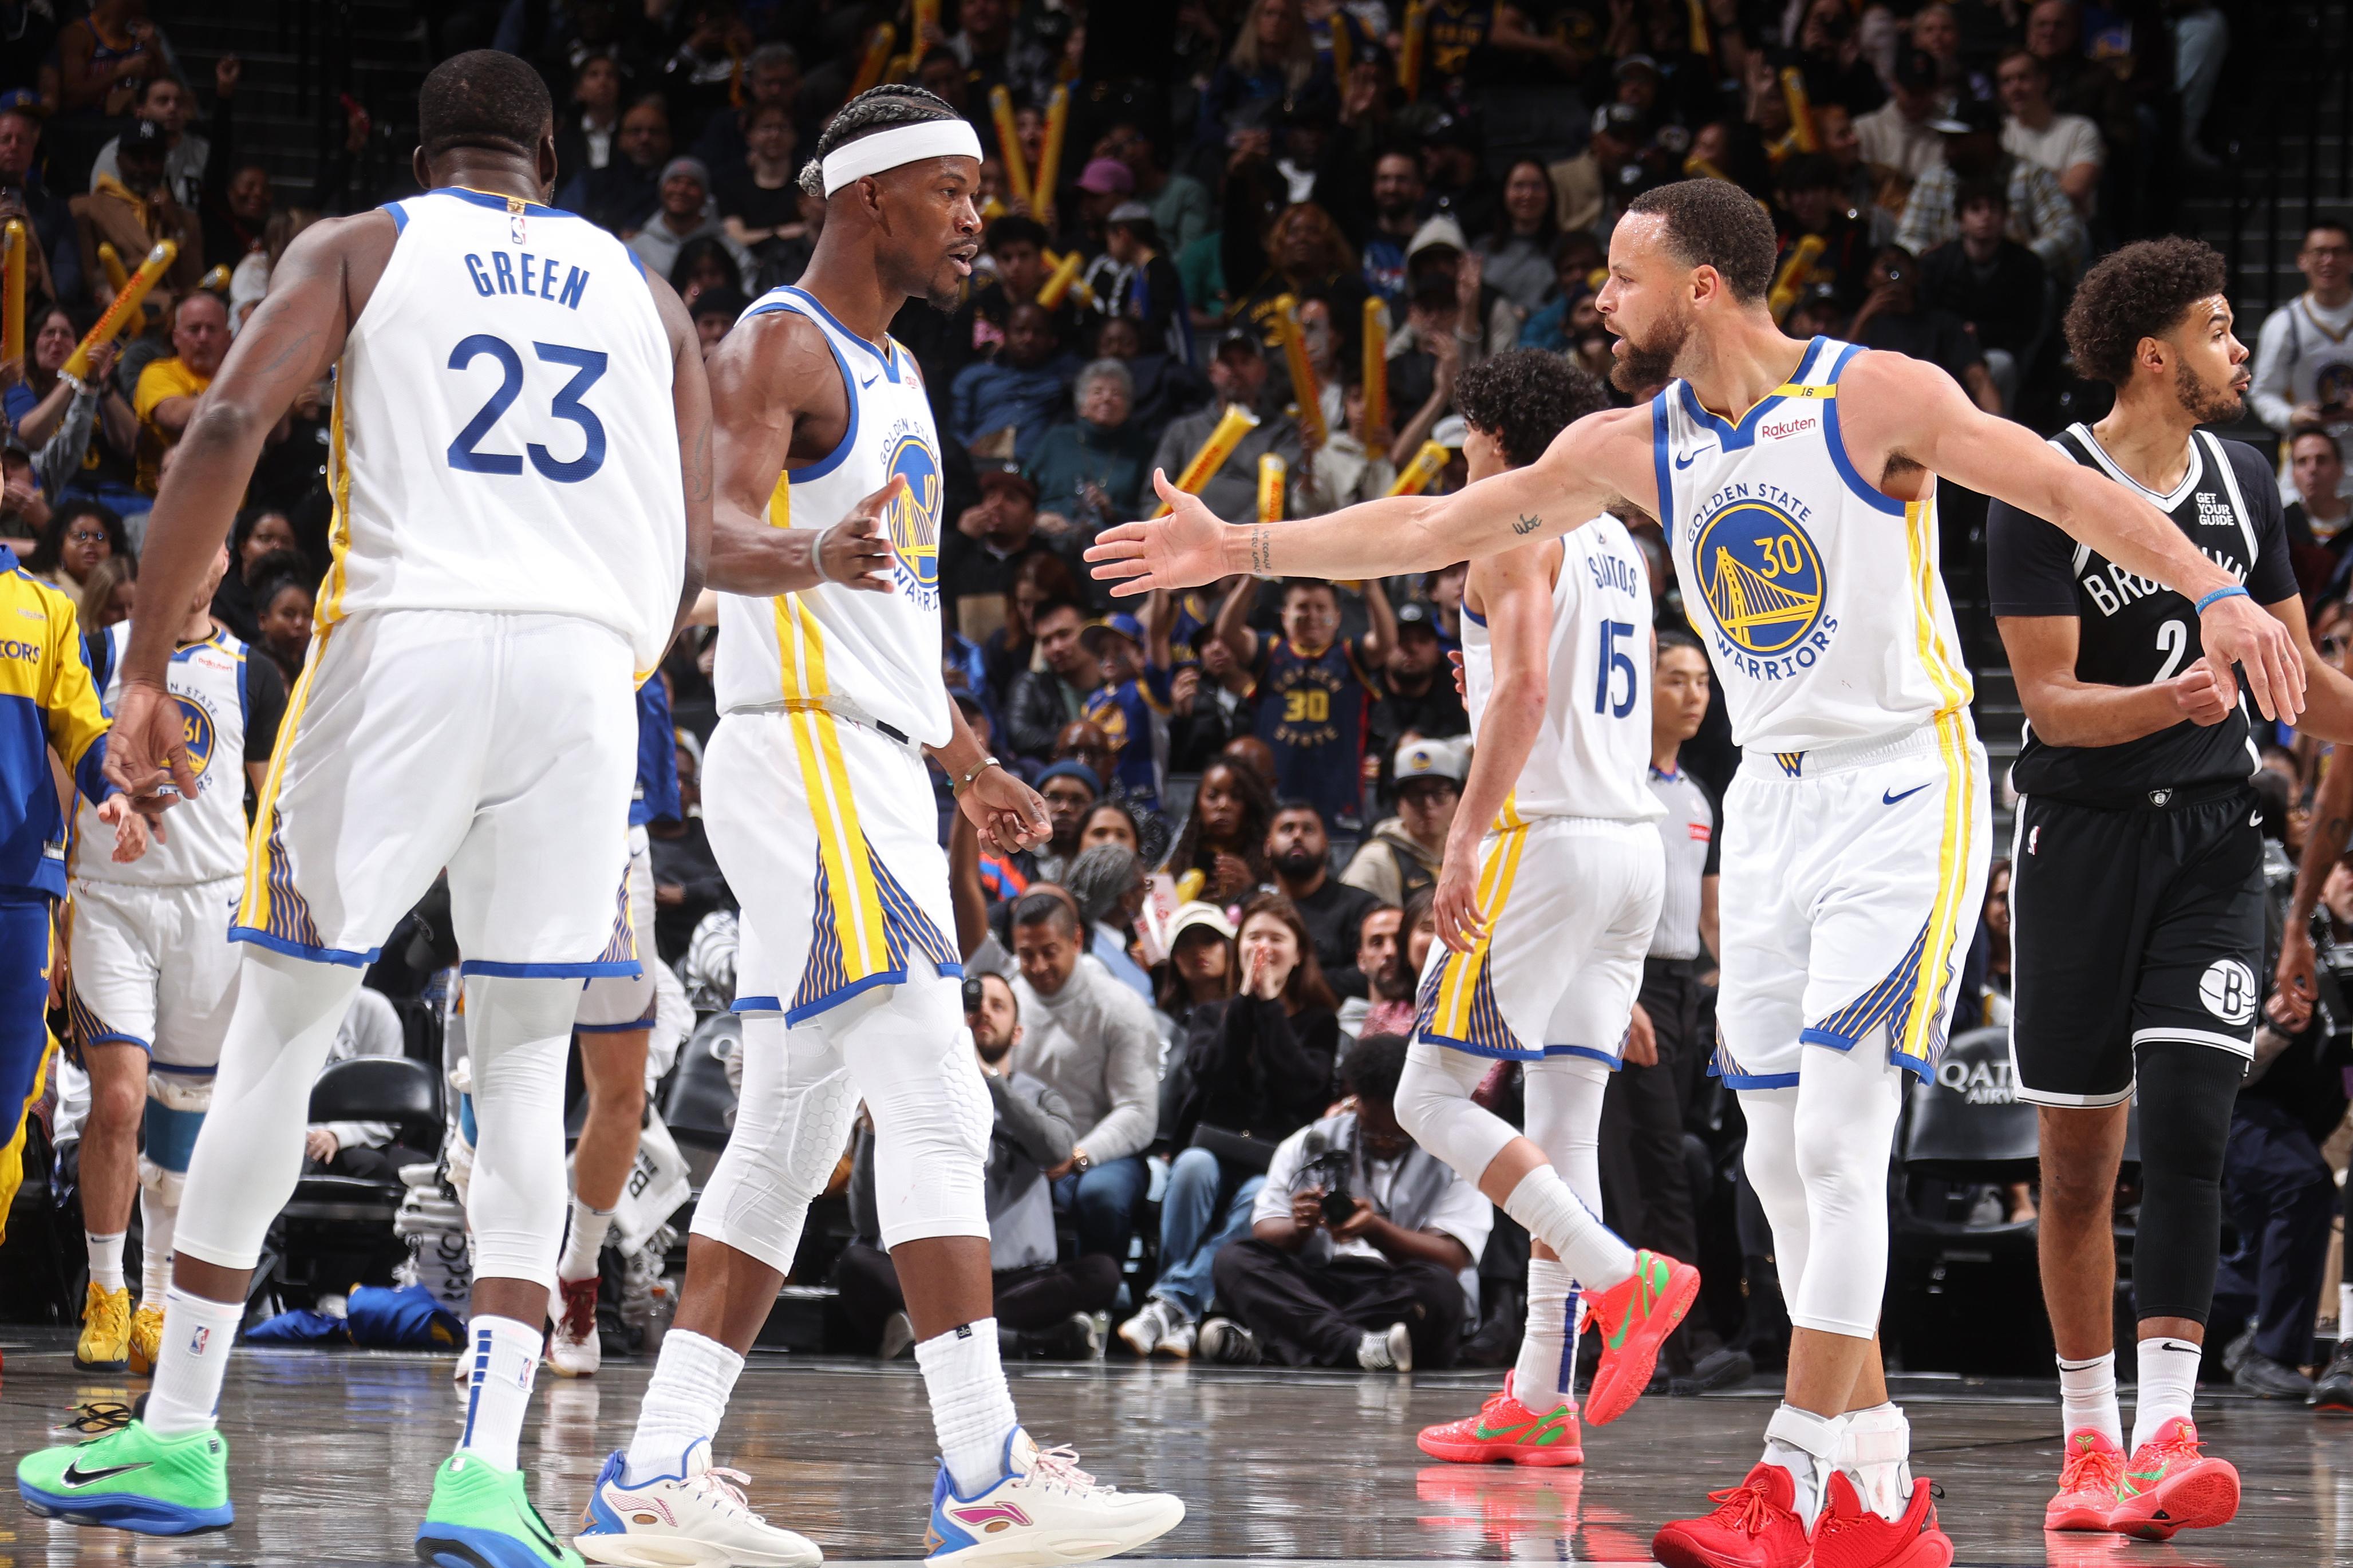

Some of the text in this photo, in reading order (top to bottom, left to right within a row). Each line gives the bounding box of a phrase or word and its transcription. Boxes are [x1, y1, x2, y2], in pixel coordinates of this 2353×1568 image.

[464, 251, 590, 310] GREEN
[447, 334, 608, 483] 23
[1801, 387, 1814, 396] 16
[880, 418, 909, 465] GOLDEN
[1762, 417, 1816, 438] Rakuten
[1688, 483, 1812, 543] GOLDEN STATE
[2196, 492, 2217, 504] GET
[2197, 503, 2231, 515] YOUR
[2198, 514, 2235, 526] GUIDE
[1754, 534, 1803, 578] 30
[1714, 614, 1838, 681] WARRIORS
[2152, 620, 2188, 683] 2
[1595, 618, 1637, 719] 15
[185, 686, 219, 716] STATE
[1282, 689, 1329, 722] 30
[183, 716, 202, 744] 61
[2222, 967, 2243, 1016] B
[1936, 1059, 2014, 1093] QAT
[958, 1327, 971, 1337] alo
